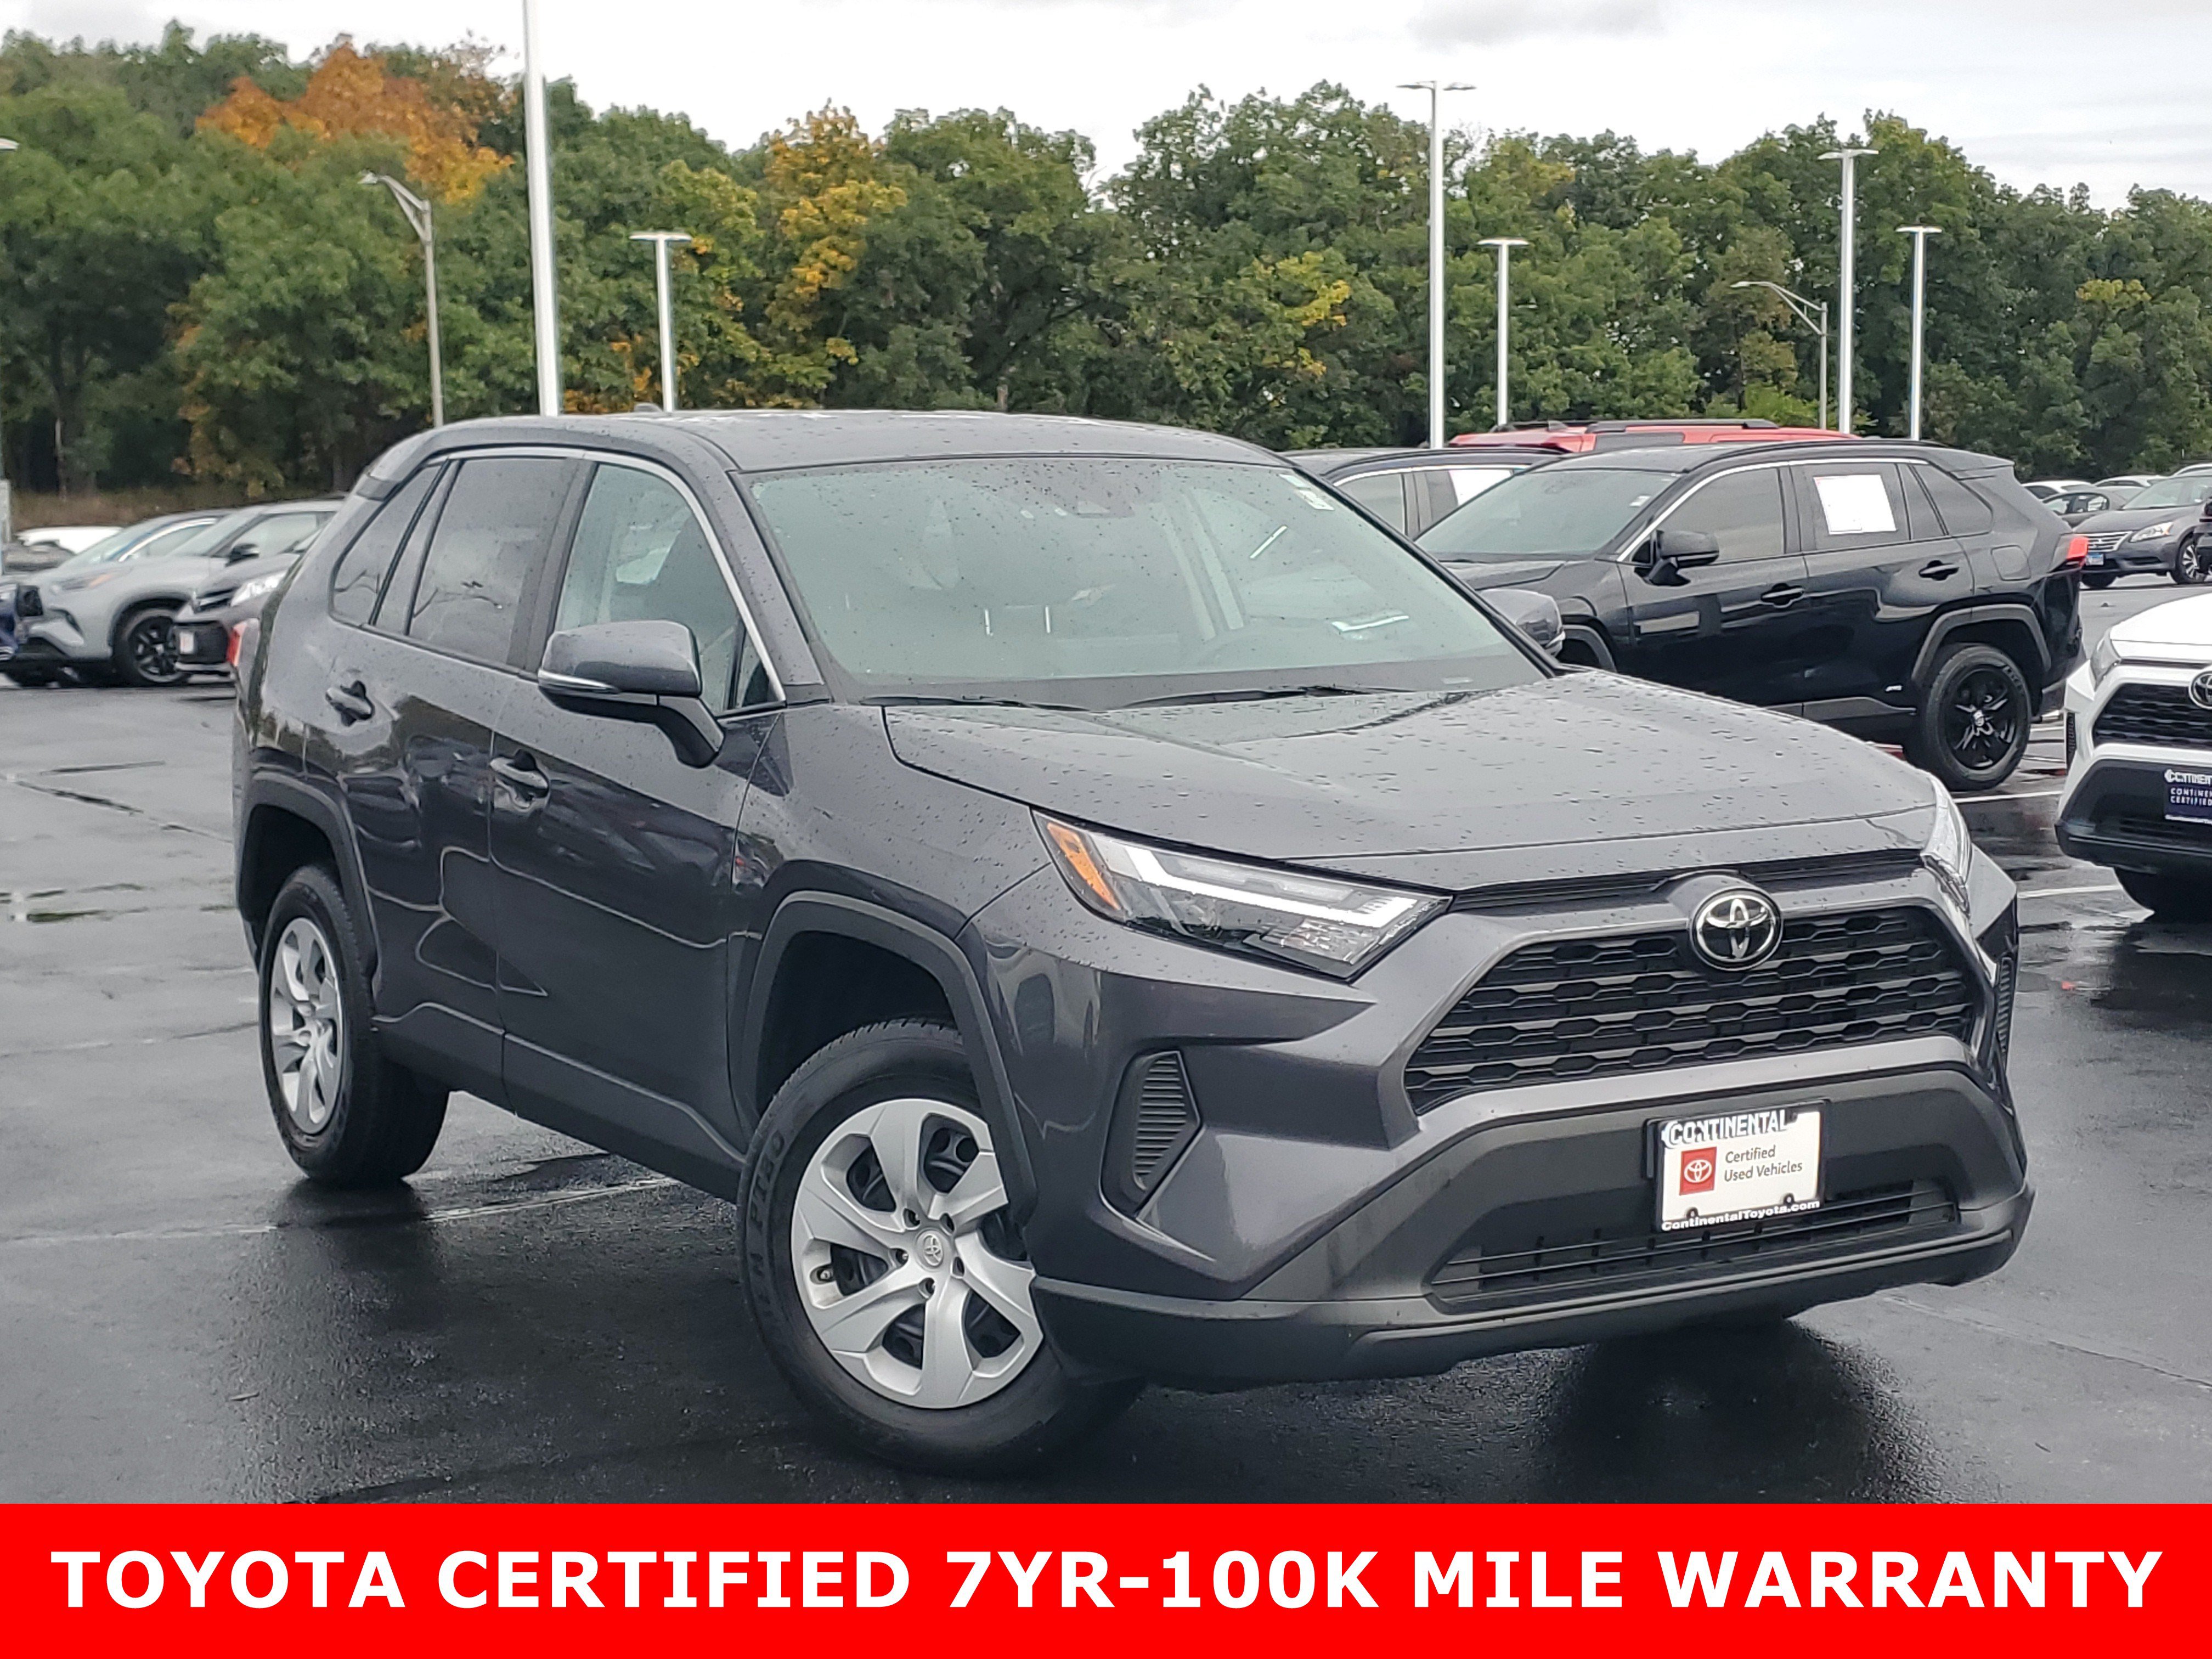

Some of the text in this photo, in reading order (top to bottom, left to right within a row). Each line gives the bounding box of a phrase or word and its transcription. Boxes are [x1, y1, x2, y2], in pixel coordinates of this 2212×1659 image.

[1661, 1109, 1788, 1148] CONTINENTAL
[1725, 1144, 1776, 1164] Certified
[1724, 1161, 1803, 1182] Used Vehicles
[1661, 1200, 1820, 1232] ContinentalToyota.com
